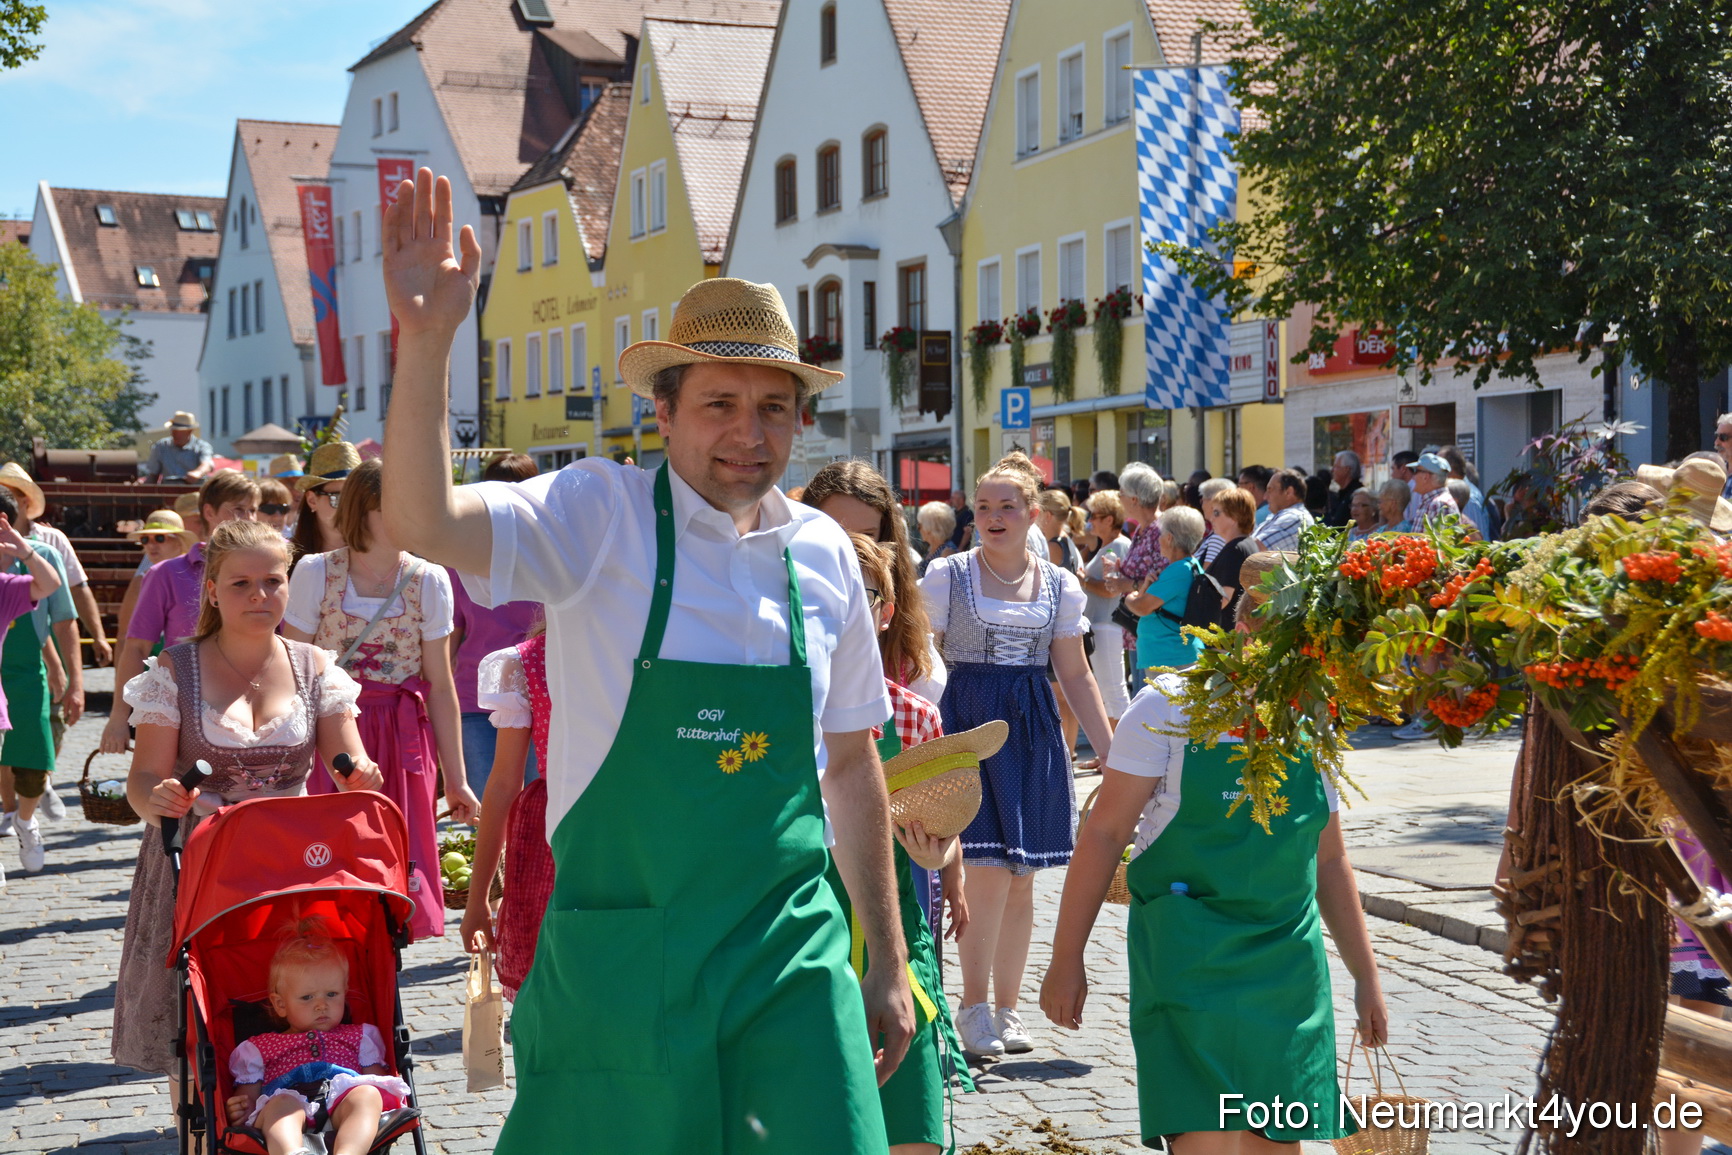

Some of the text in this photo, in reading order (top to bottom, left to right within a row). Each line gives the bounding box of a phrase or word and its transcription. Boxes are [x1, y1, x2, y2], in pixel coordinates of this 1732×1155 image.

[309, 191, 329, 239] K&L
[532, 296, 560, 323] HOTEL
[1358, 340, 1387, 354] DER
[1235, 355, 1252, 372] KINO
[1267, 323, 1277, 396] KINO
[1309, 352, 1326, 369] DER
[1630, 374, 1639, 390] 16
[1007, 392, 1024, 425] P
[697, 708, 725, 722] OGV
[676, 727, 741, 743] Rittershof
[305, 843, 331, 867] VW
